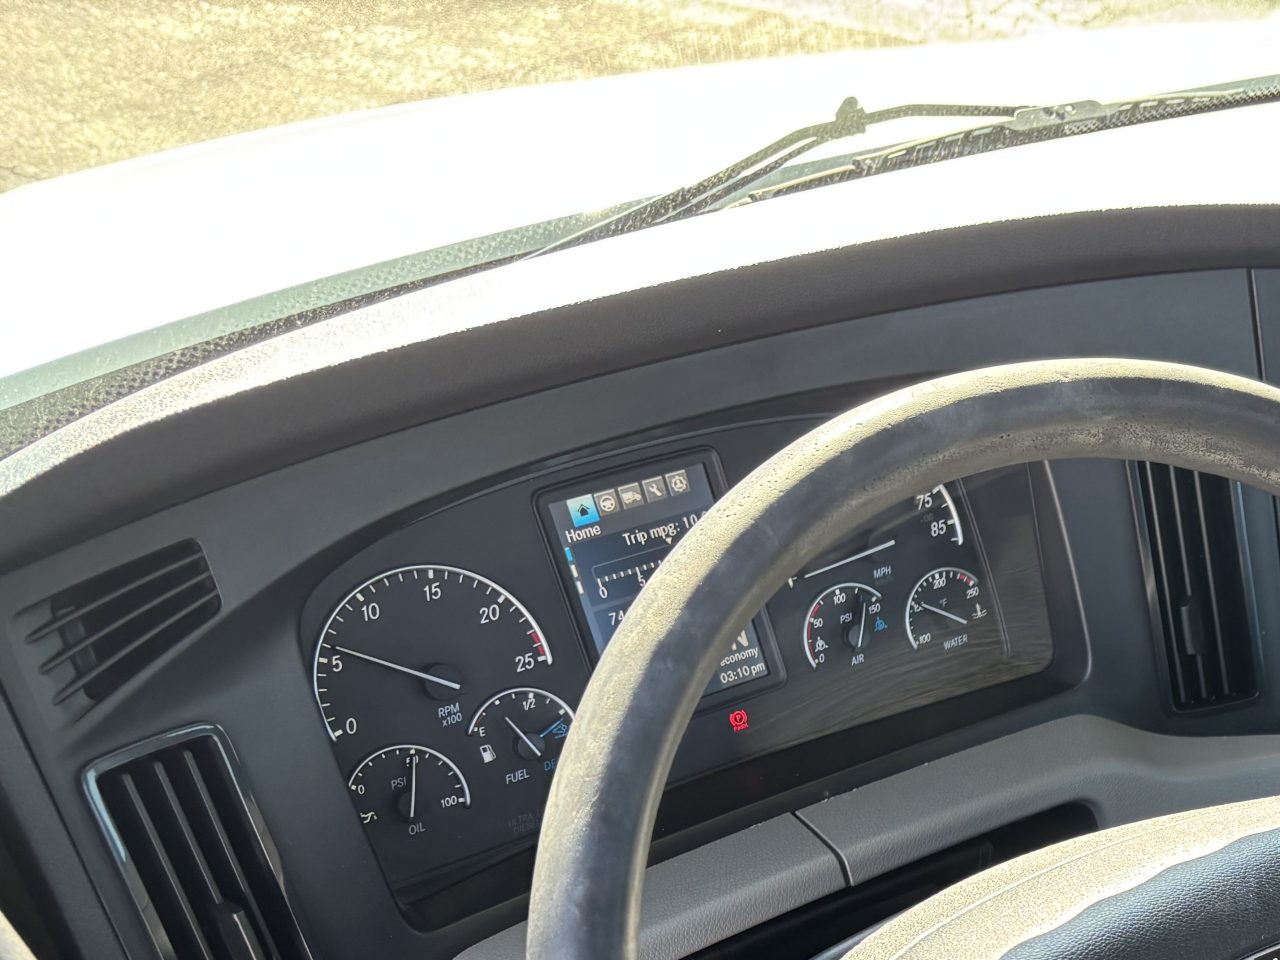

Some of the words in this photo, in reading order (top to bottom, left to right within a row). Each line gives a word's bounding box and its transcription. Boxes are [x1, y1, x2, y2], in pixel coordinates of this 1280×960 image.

[916, 492, 933, 510] 75
[565, 525, 601, 543] Home
[622, 530, 647, 545] Trip
[650, 522, 680, 540] mpg:
[931, 519, 946, 537] 85
[873, 565, 892, 579] MPH
[423, 582, 442, 602] 15
[833, 593, 846, 605] 100
[966, 586, 979, 599] 250
[361, 602, 380, 621] 10
[479, 604, 500, 624] 20
[868, 603, 881, 615] 150
[813, 618, 823, 628] 50
[840, 612, 852, 624] PSI
[943, 634, 968, 650] WATER
[332, 655, 343, 673] 5
[515, 653, 535, 673] 25
[819, 653, 825, 663] 0
[851, 653, 864, 666] AIR
[720, 665, 750, 684] 03:10
[751, 662, 766, 677] pm
[438, 702, 460, 718] RPM
[523, 698, 536, 711] 1/2
[346, 717, 357, 735] 0
[442, 712, 462, 727] x100
[479, 726, 486, 737] E
[544, 758, 558, 772] DE
[505, 768, 530, 784] FUEL
[358, 784, 365, 795] 0
[391, 777, 407, 790] PSI
[441, 795, 458, 808] 100
[408, 822, 426, 836] OIL
